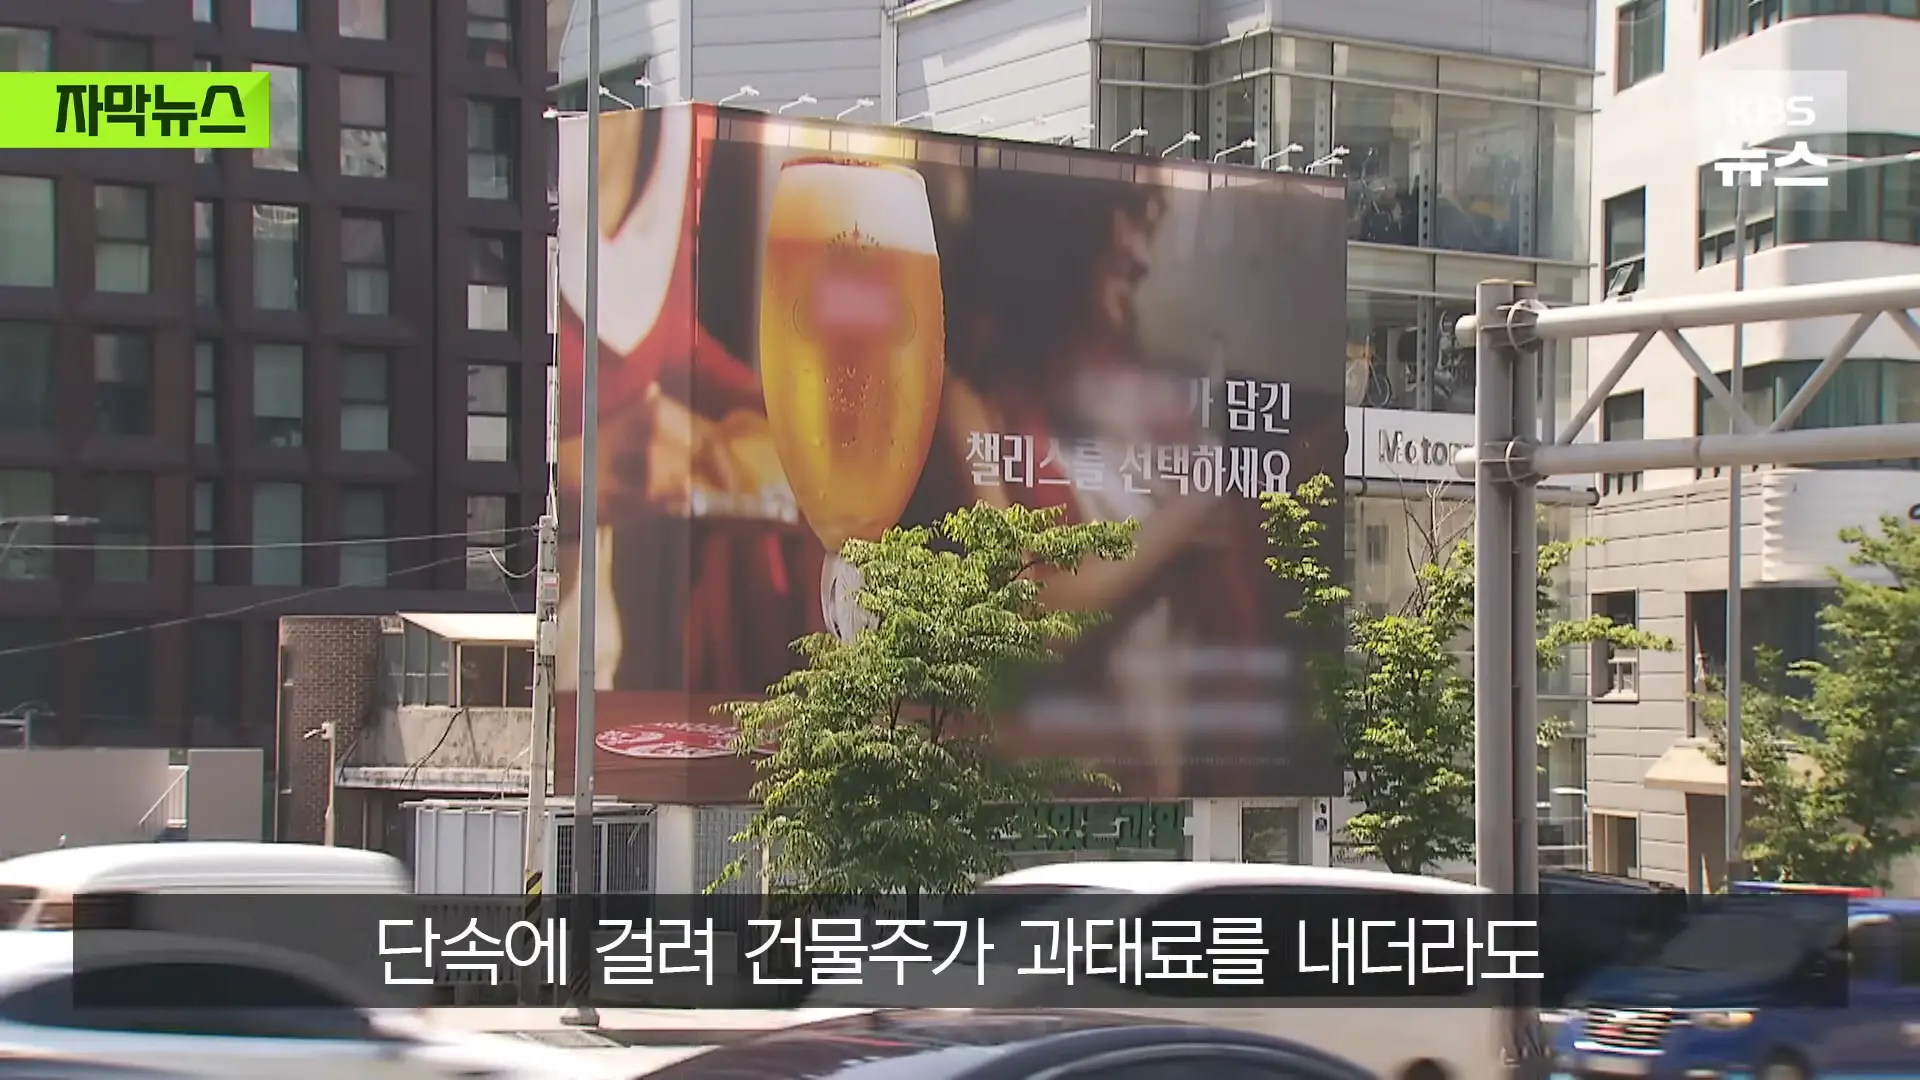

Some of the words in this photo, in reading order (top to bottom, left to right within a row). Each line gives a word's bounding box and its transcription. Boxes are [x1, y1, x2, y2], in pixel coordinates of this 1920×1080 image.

[1226, 379, 1291, 434] 담긴
[965, 430, 1105, 491] 챌리스를
[1119, 444, 1291, 499] 선택하세요
[1378, 429, 1474, 467] Motor
